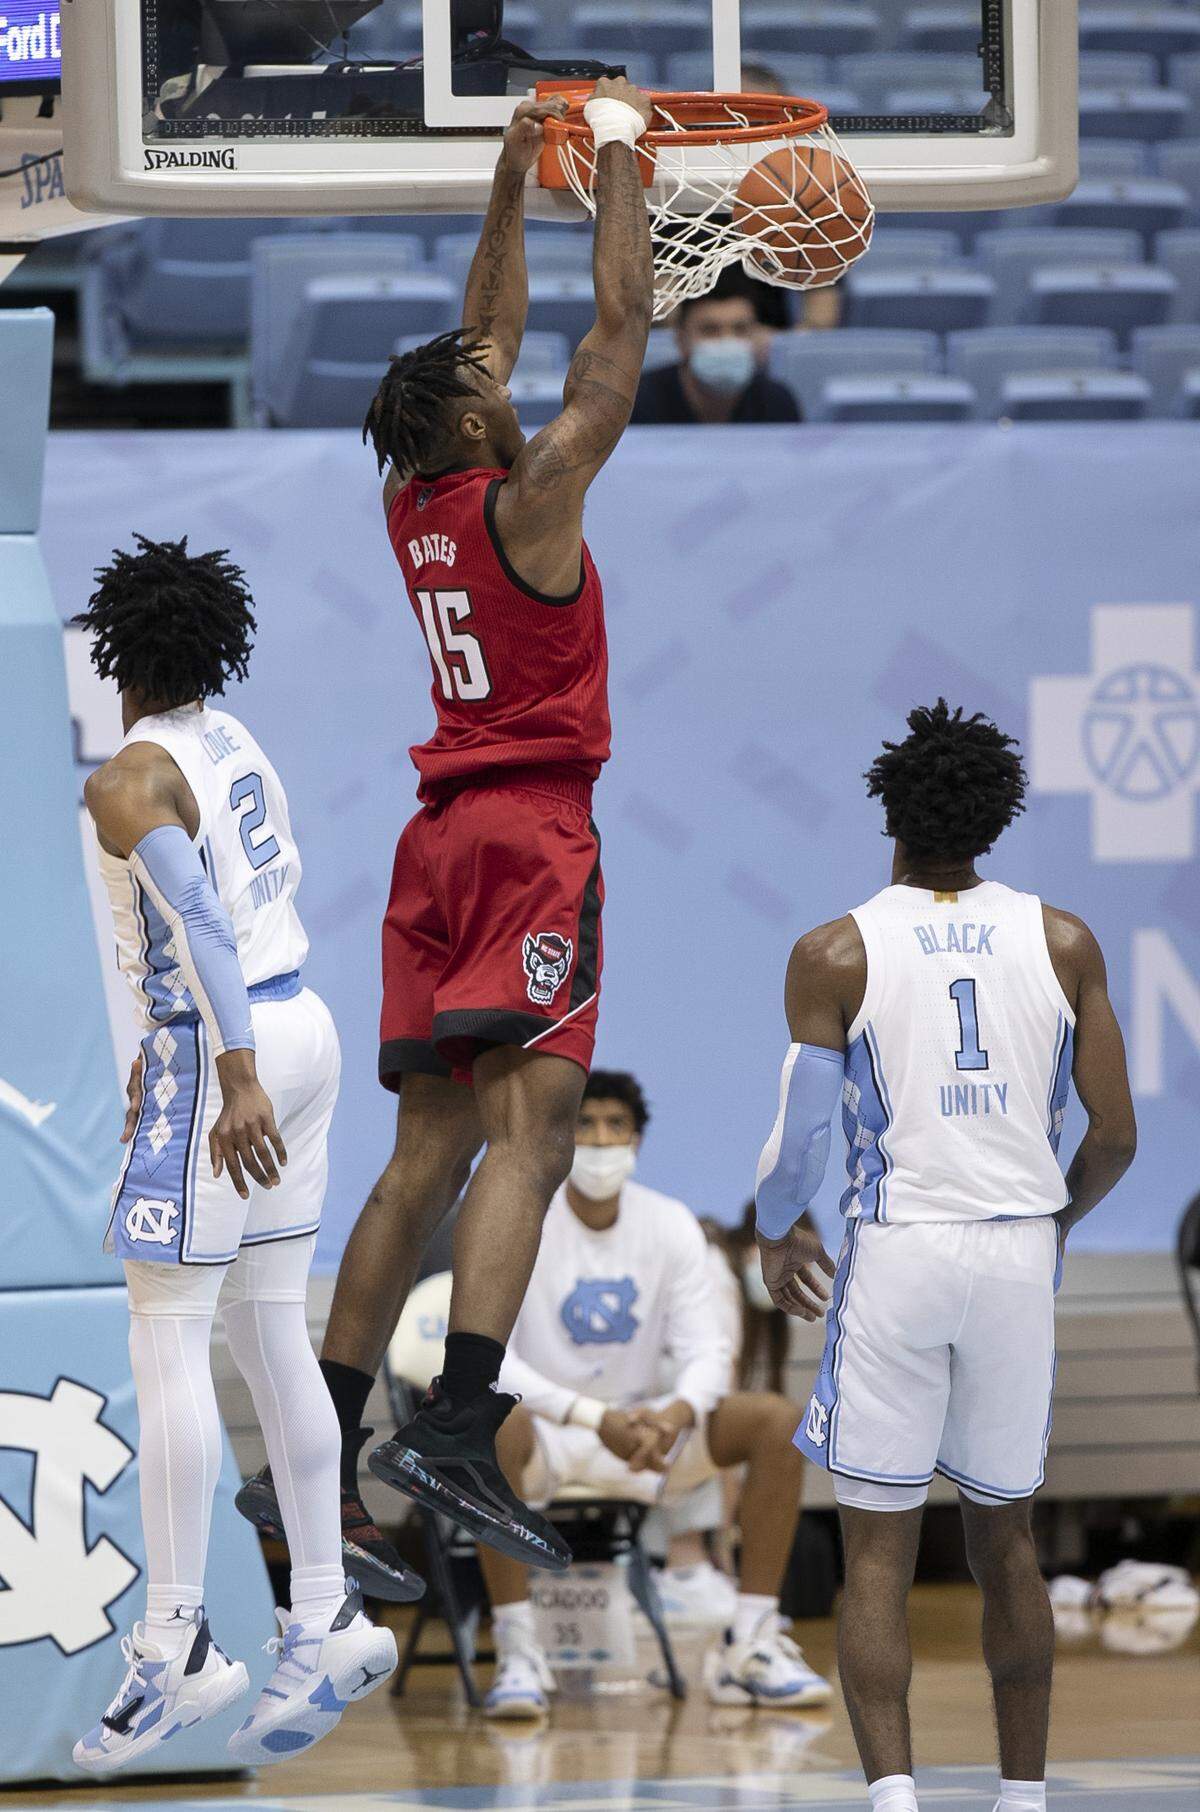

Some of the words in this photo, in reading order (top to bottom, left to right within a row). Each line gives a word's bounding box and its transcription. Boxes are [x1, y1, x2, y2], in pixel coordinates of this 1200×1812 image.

[143, 148, 235, 171] SPALDING
[407, 533, 457, 570] BATES
[414, 589, 493, 701] 15
[200, 725, 241, 766] LOVE
[229, 771, 281, 870] 2
[249, 863, 289, 911] UNITY
[913, 922, 997, 956] BLACK
[949, 978, 989, 1071] 1
[938, 1081, 1008, 1117] UNITY
